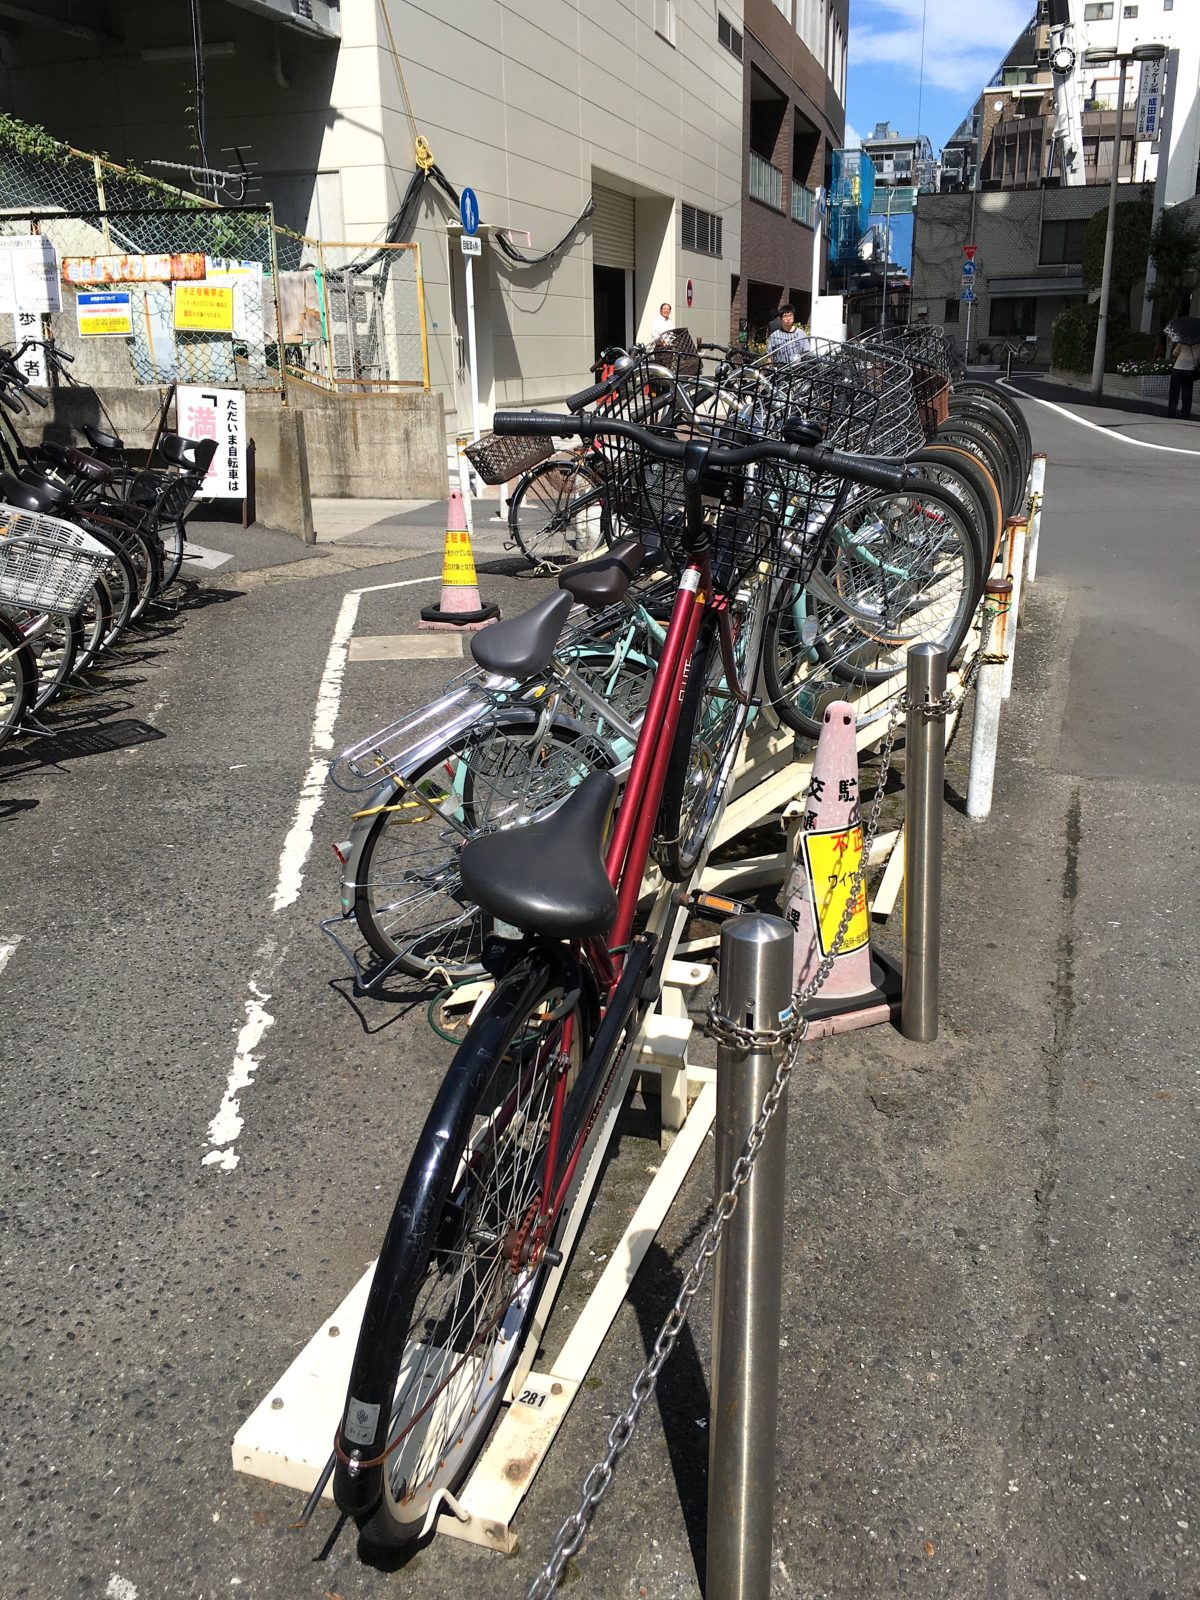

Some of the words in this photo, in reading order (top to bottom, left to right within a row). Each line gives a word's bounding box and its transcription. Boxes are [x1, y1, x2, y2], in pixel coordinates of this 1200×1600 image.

[1145, 97, 1157, 133] 成田歯科
[226, 399, 240, 492] ただいま自転車は
[519, 1390, 546, 1407] 281
